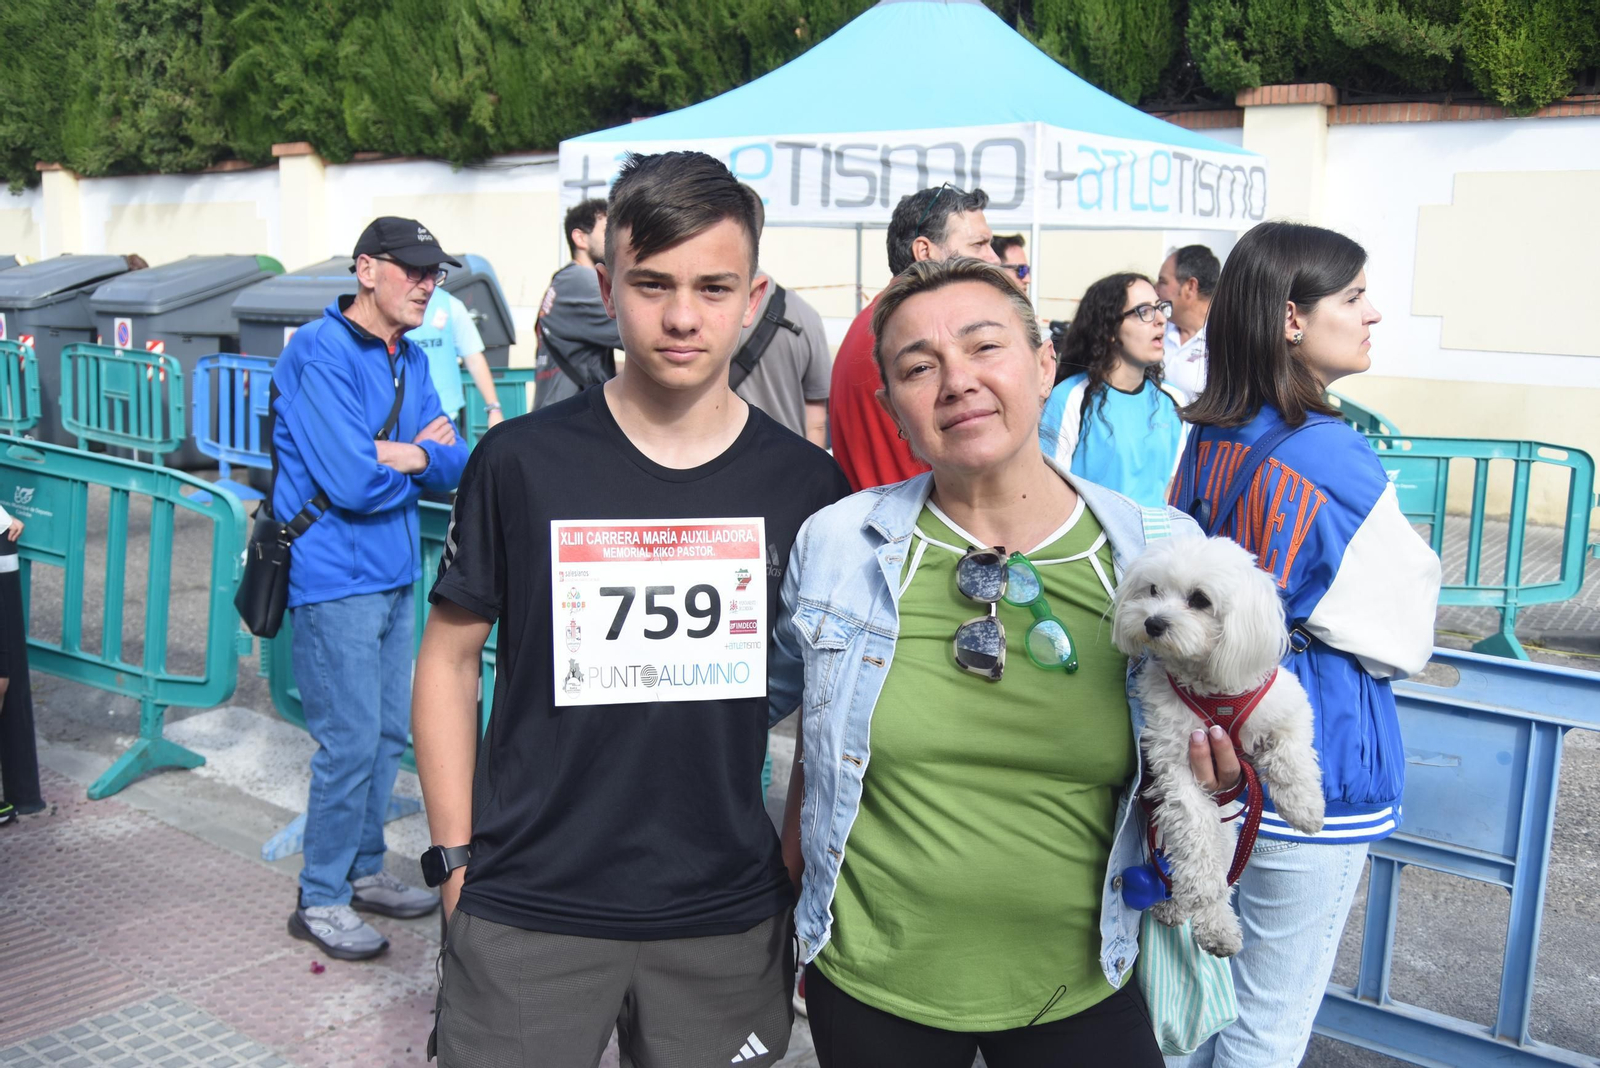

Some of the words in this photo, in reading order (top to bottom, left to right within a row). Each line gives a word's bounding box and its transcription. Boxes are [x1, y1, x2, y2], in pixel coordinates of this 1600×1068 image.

[560, 531, 583, 546] XLIII
[586, 530, 640, 545] CARRERA
[642, 528, 677, 544] MARÍA
[680, 529, 757, 543] AUXILIADORA.
[603, 547, 651, 558] MEMORIAL
[653, 546, 675, 557] KIKO
[677, 546, 716, 557] PASTOR.
[599, 583, 722, 641] 759
